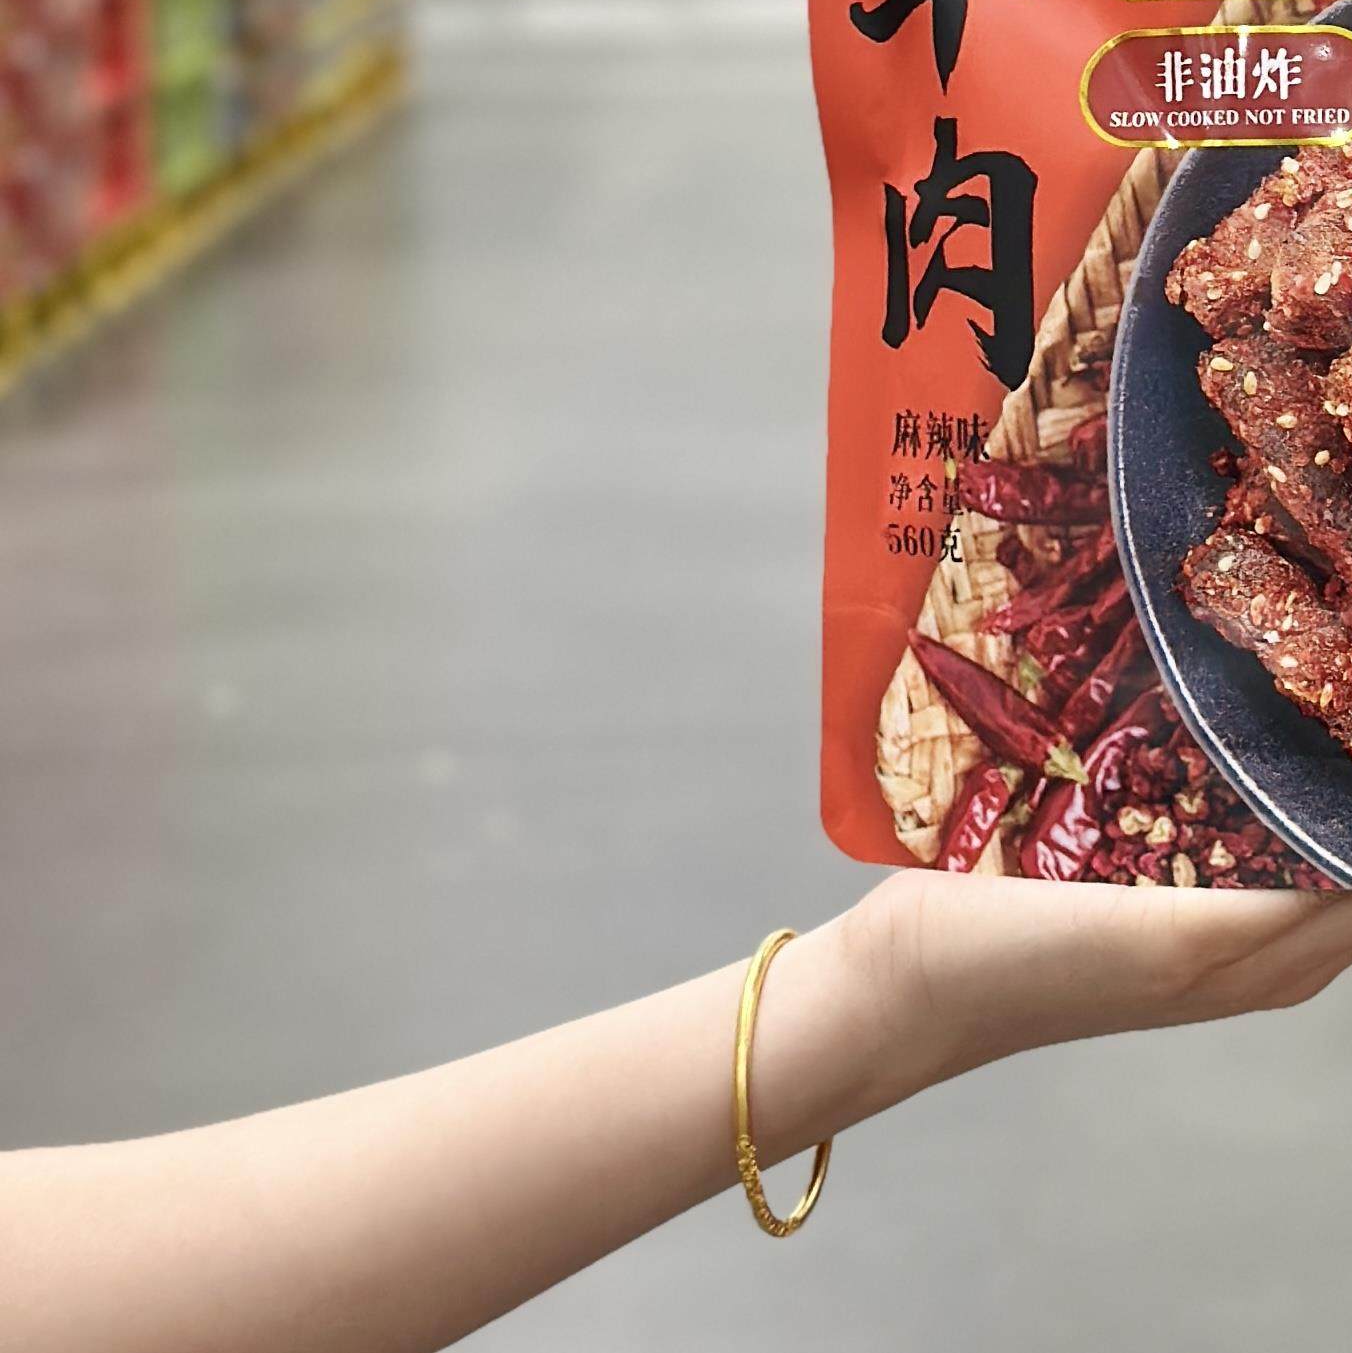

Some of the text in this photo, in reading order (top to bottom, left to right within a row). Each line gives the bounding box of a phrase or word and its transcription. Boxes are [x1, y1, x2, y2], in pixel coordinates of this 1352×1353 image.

[1154, 46, 1304, 103] 非油炸
[1109, 108, 1351, 128] SLOW COOKED NOT FRIED
[891, 408, 992, 465] 麻辣味
[886, 522, 964, 563] 560克
